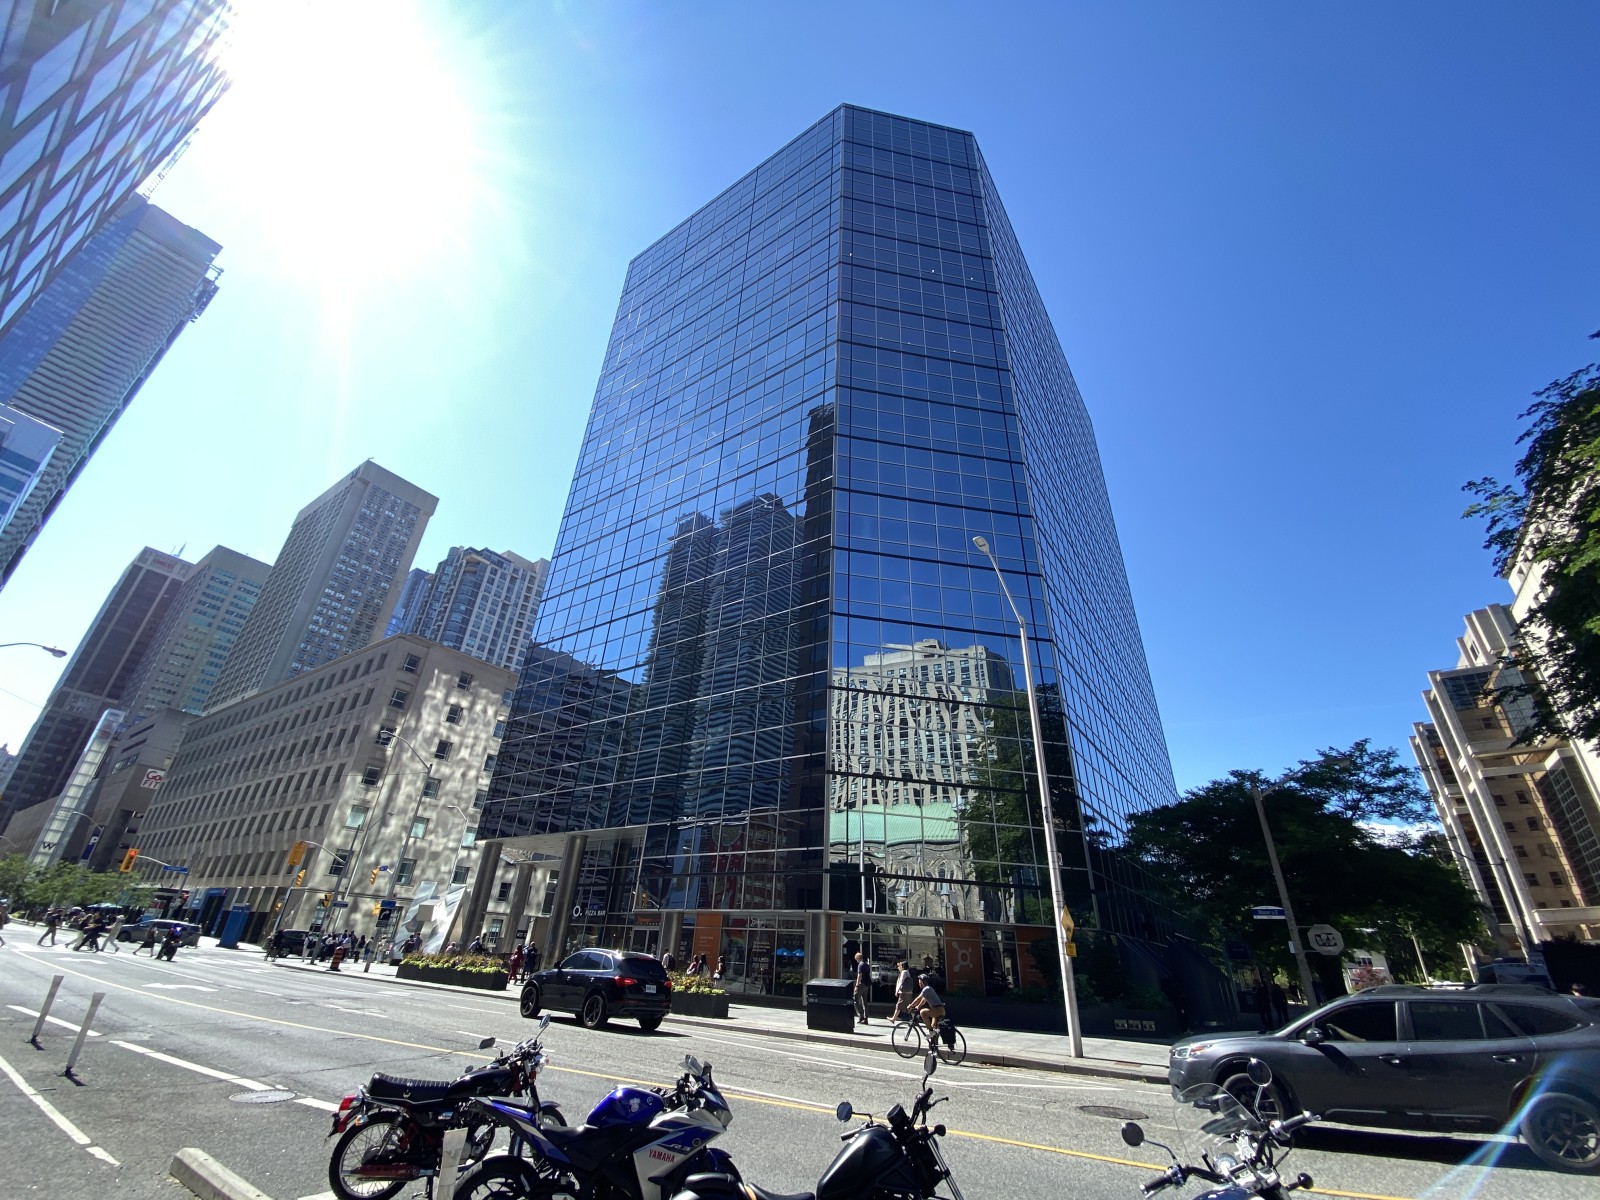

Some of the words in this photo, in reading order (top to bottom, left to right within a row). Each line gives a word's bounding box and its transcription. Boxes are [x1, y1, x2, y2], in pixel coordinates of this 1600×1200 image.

[43, 841, 57, 851] W
[89, 836, 99, 846] P
[649, 1148, 675, 1163] YAMAHA
